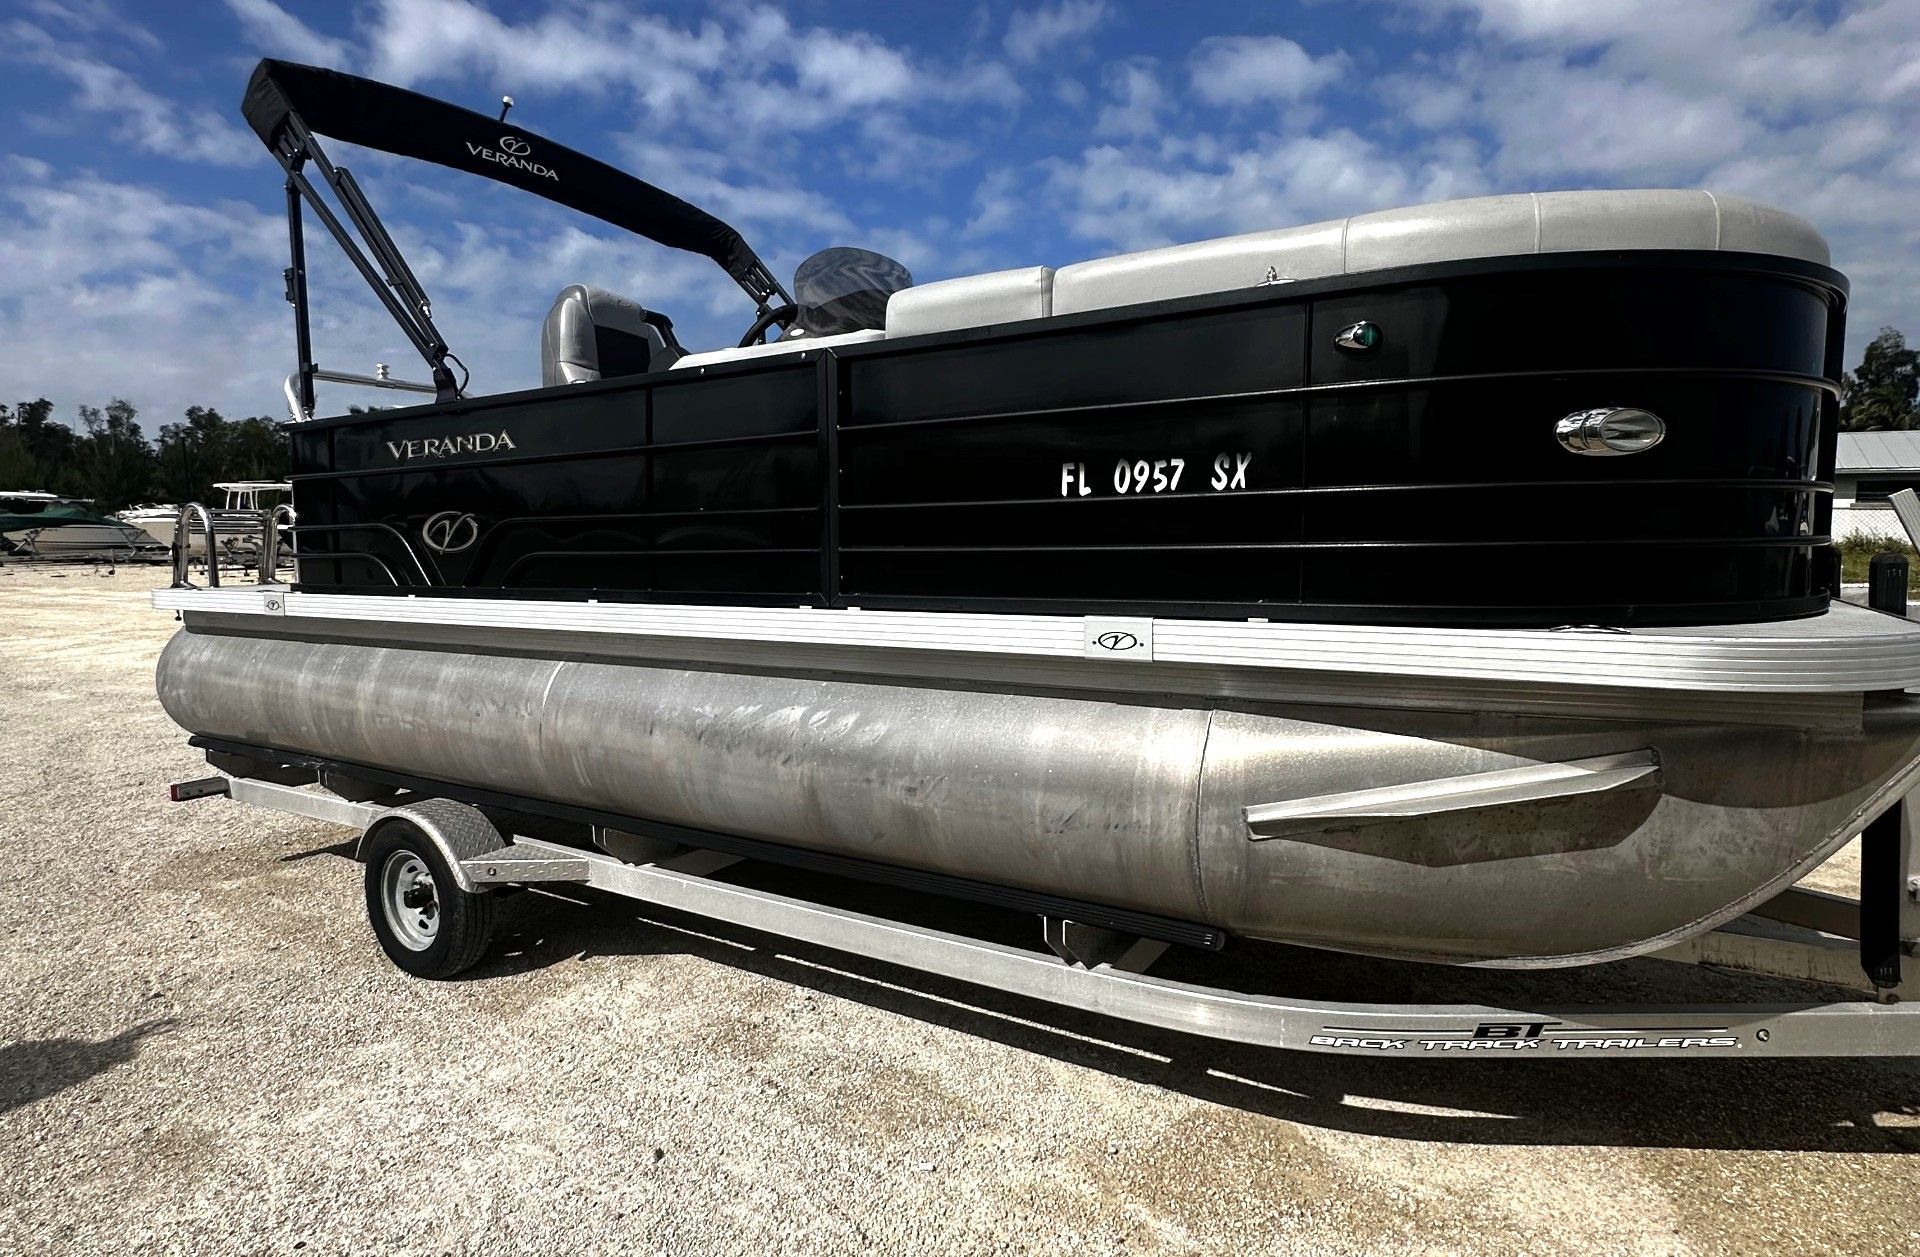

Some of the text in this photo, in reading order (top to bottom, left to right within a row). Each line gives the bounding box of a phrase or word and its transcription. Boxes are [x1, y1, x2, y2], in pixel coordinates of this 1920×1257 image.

[465, 141, 560, 181] VERANDA
[386, 429, 517, 460] VERANDA
[1061, 452, 1252, 497] FL 0957 SX
[1309, 1035, 1414, 1050] BACK
[1417, 1038, 1547, 1050] TRACK
[1473, 1023, 1562, 1038] BT
